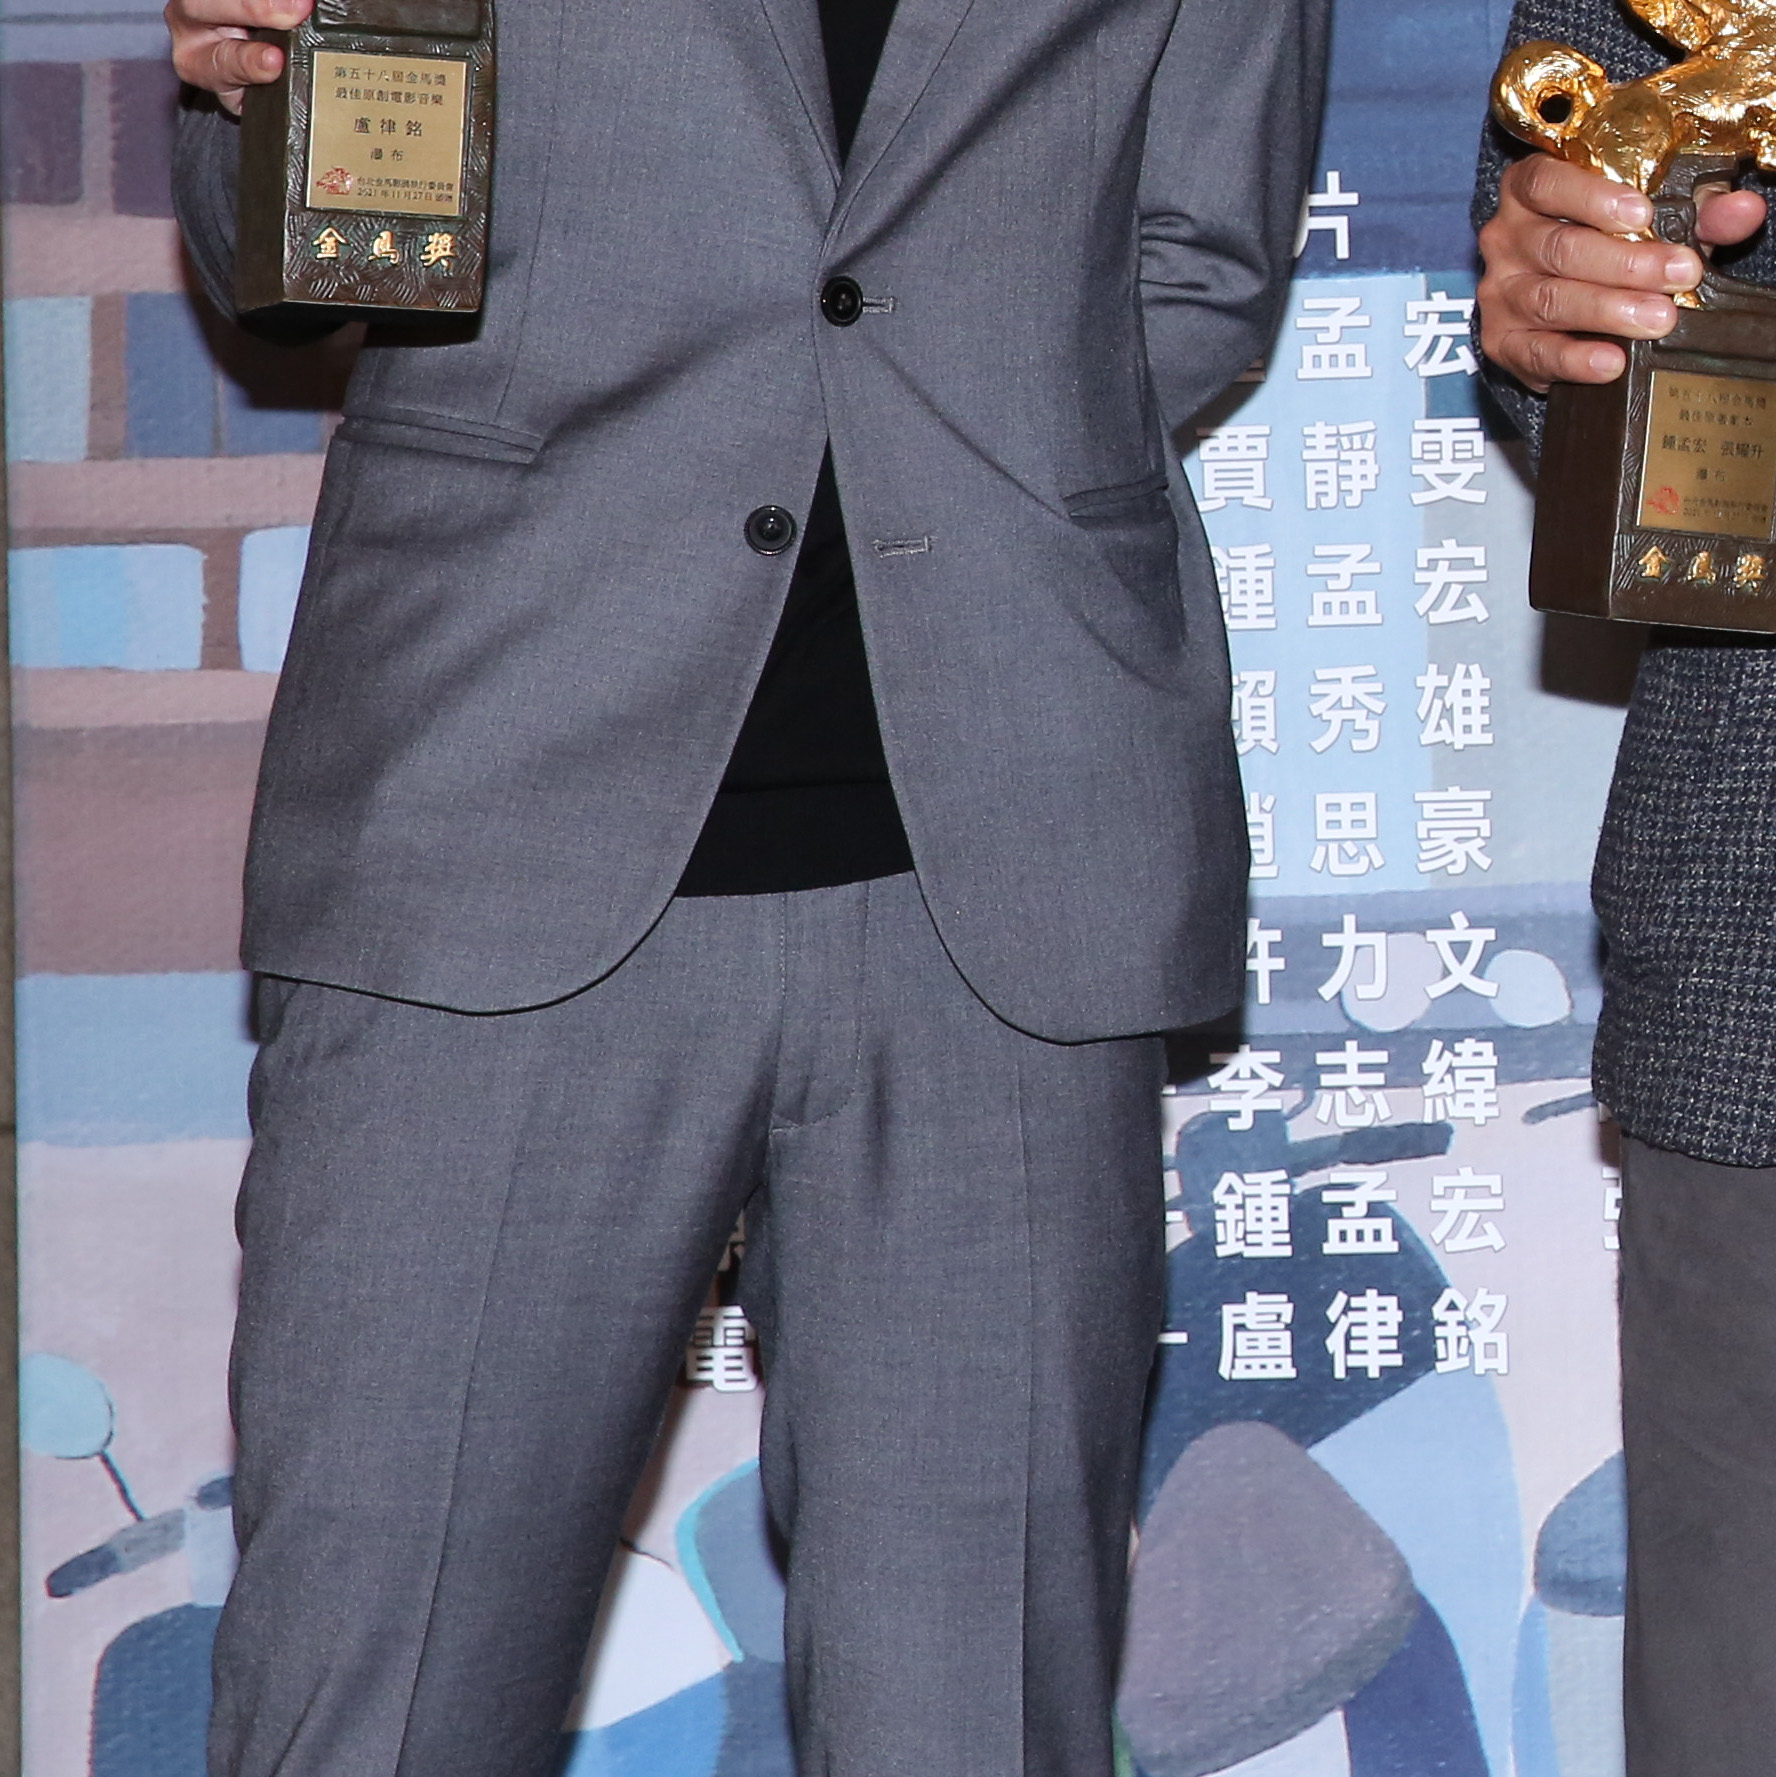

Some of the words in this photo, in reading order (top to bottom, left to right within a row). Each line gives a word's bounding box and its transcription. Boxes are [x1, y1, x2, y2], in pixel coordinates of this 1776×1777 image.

[353, 117, 424, 137] 盧律銘
[312, 227, 457, 270] 金馬獎
[1196, 417, 1488, 514] 賈靜雯
[1207, 1037, 1500, 1132] 李志緯
[1211, 1166, 1507, 1260] 鍾孟宏
[1218, 1287, 1511, 1382] 盧律銘
